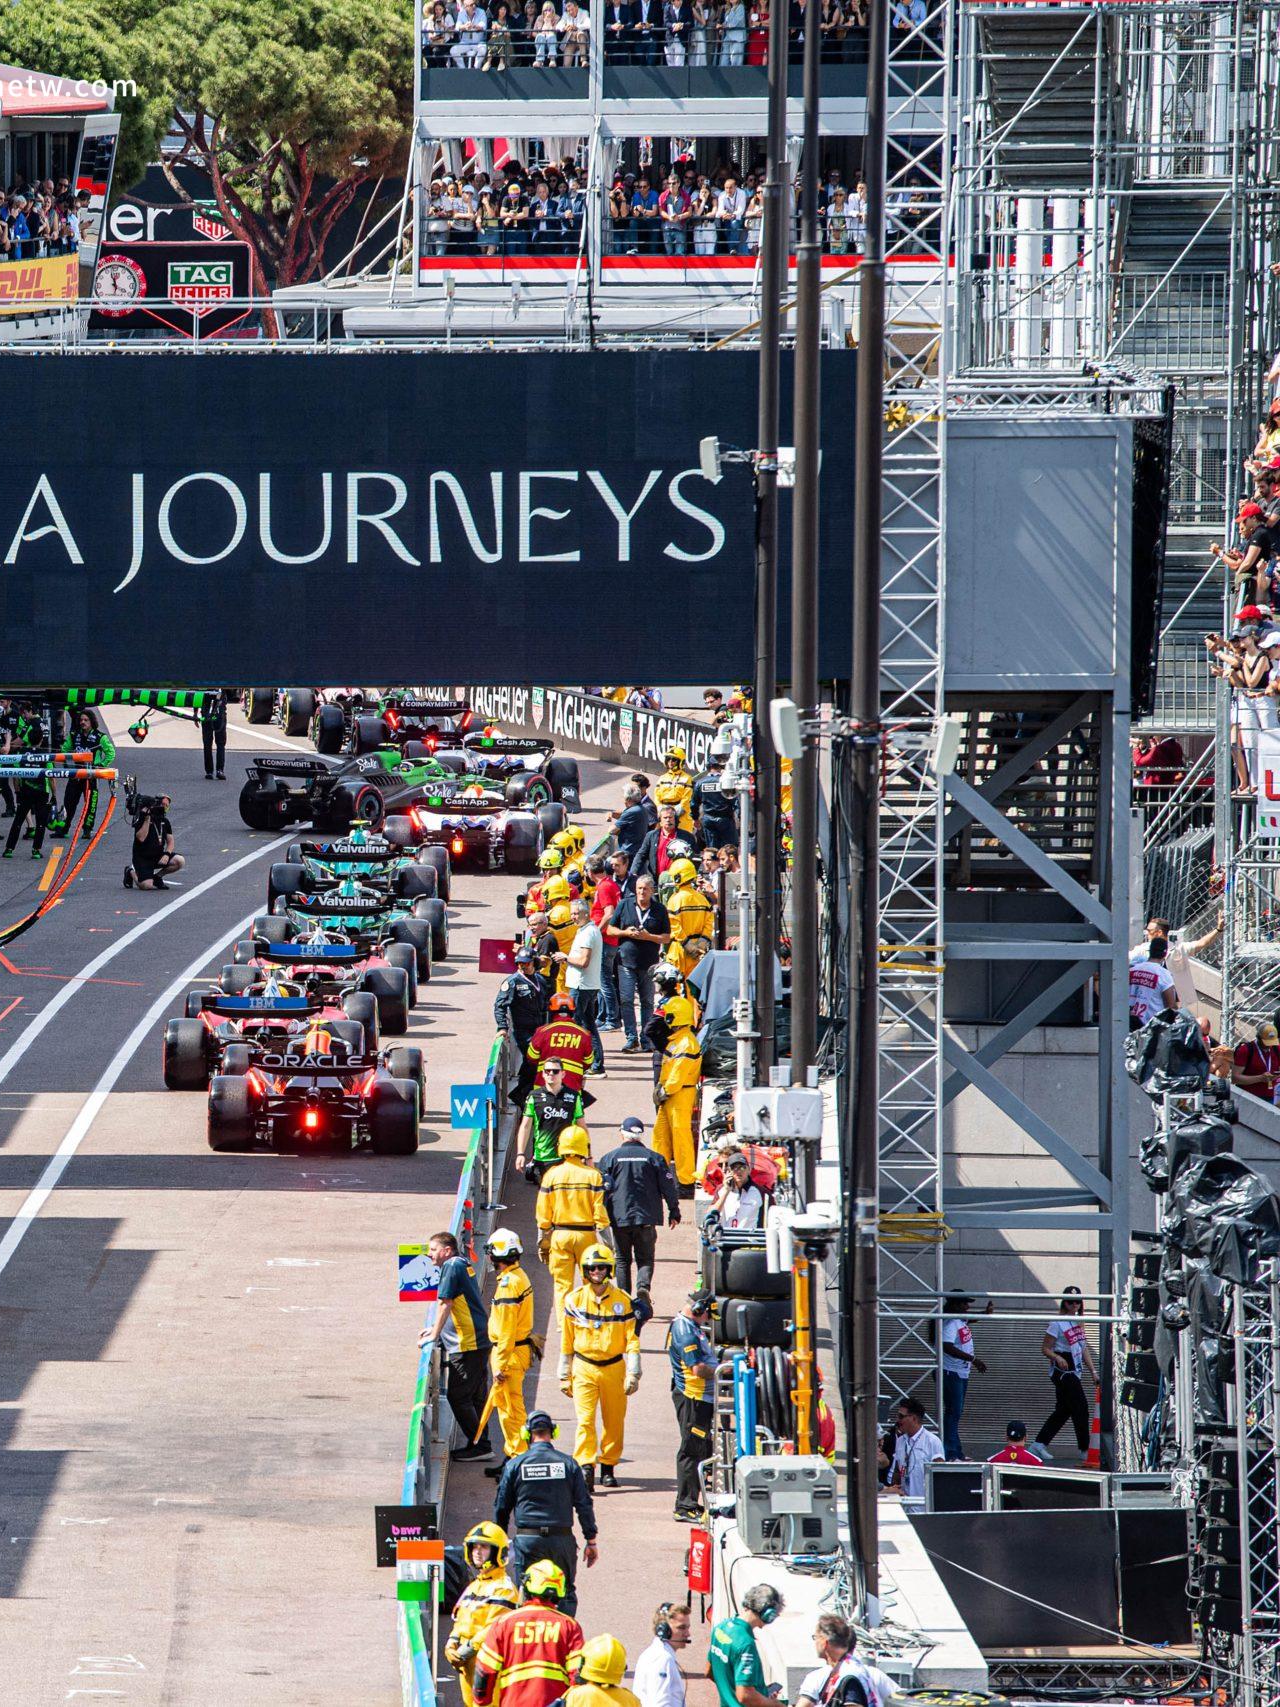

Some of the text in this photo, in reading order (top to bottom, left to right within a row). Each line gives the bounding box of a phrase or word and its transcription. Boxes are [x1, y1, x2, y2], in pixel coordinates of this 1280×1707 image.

[173, 266, 227, 283] TAG
[113, 470, 726, 593] JOURNEYS
[547, 691, 616, 749] TAGHeuer
[523, 739, 537, 747] App
[27, 753, 50, 763] Gulf
[266, 760, 311, 768] COINPAYMENTS
[355, 757, 377, 772] Stake
[45, 769, 70, 778] Gulf
[422, 784, 453, 798] Stake
[470, 798, 489, 807] App
[332, 843, 387, 854] Valvoline
[318, 896, 377, 907] Valvoline
[300, 945, 325, 956] IBM
[249, 997, 275, 1008] IBM
[549, 1033, 582, 1049] CSPM
[262, 1055, 363, 1068] ORACLE
[453, 1097, 479, 1118] W
[544, 1106, 569, 1119] Stake
[784, 1472, 797, 1482] 30
[400, 1526, 422, 1535] BWT
[513, 1621, 561, 1644] CSPM
